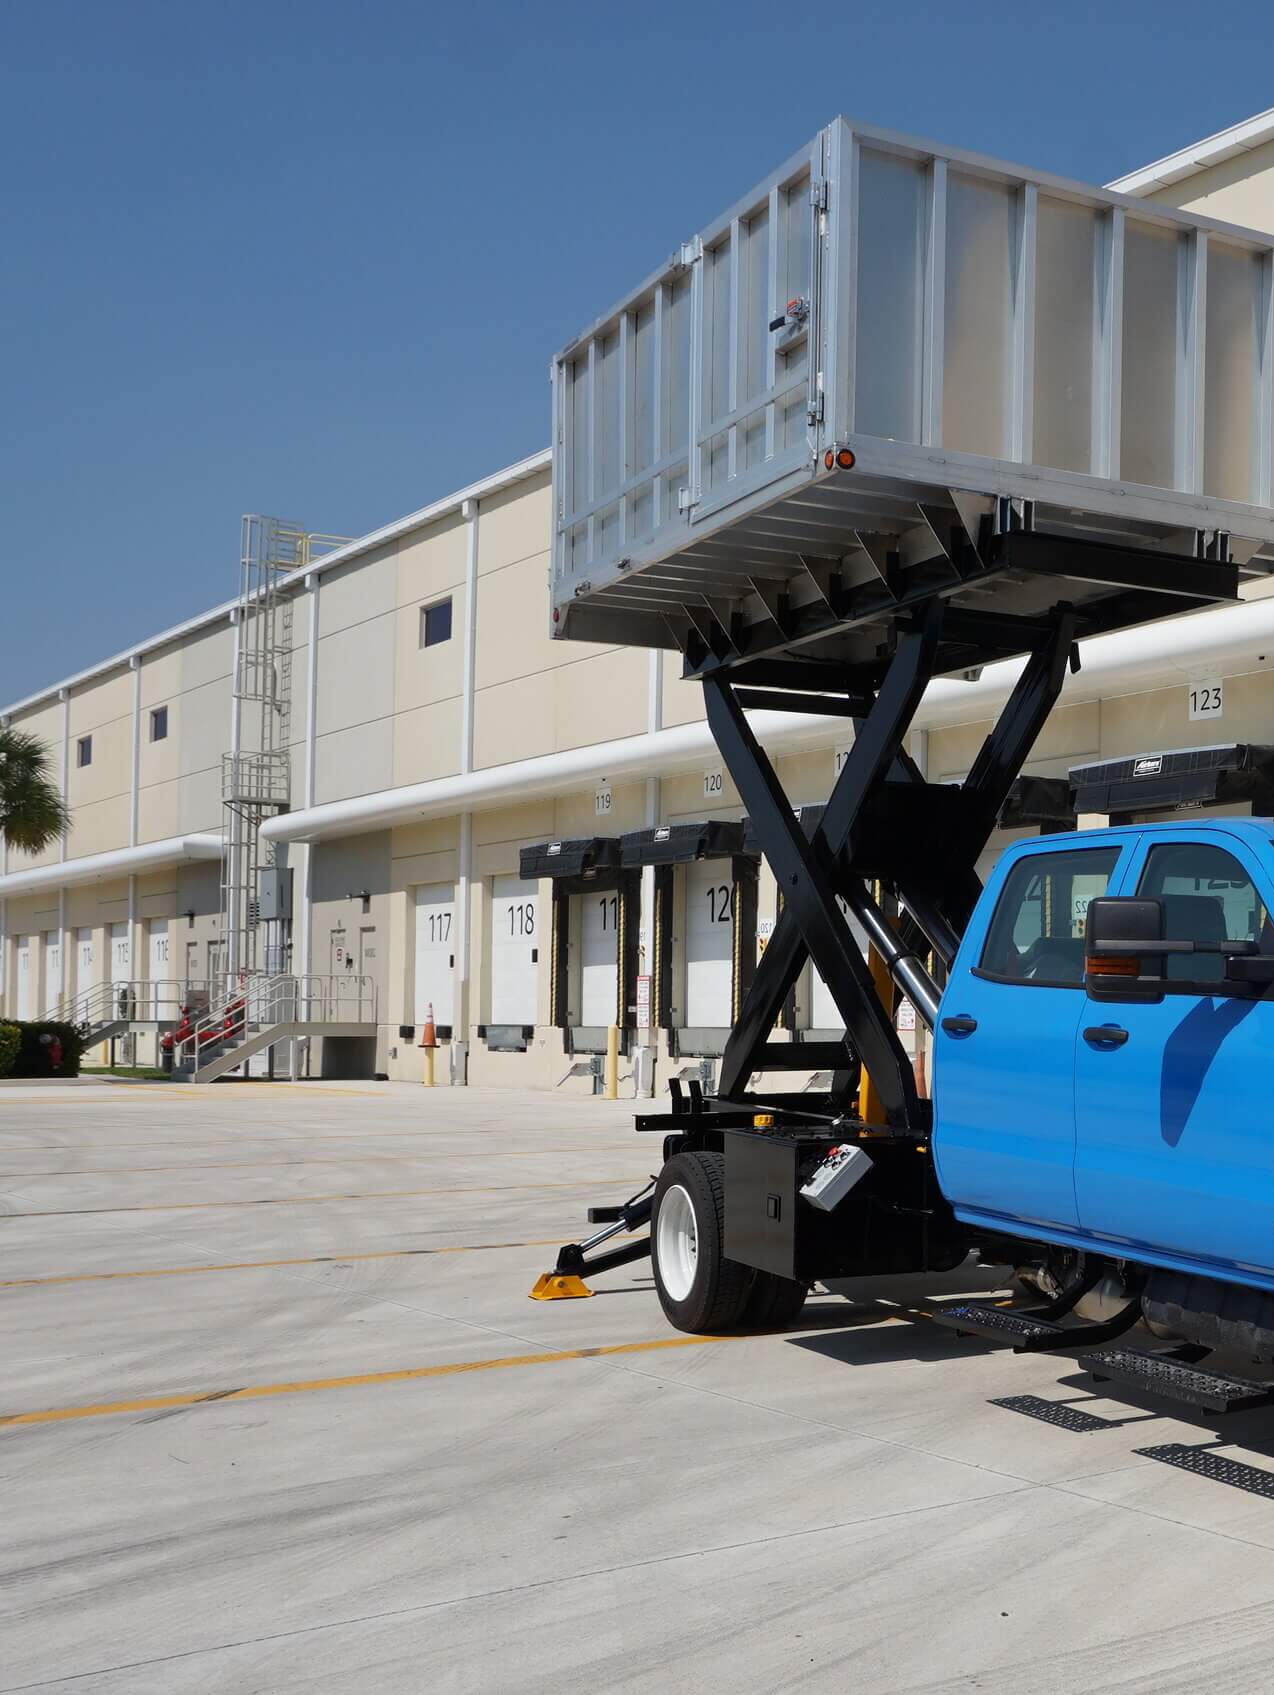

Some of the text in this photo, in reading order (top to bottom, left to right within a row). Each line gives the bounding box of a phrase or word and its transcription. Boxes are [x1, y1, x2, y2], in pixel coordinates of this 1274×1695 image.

[1190, 687, 1222, 713] 123
[704, 774, 722, 792] 120
[595, 793, 611, 810] 119
[507, 903, 535, 936] 118
[600, 897, 617, 931] 11
[706, 885, 734, 924] 12
[429, 912, 452, 942] 117
